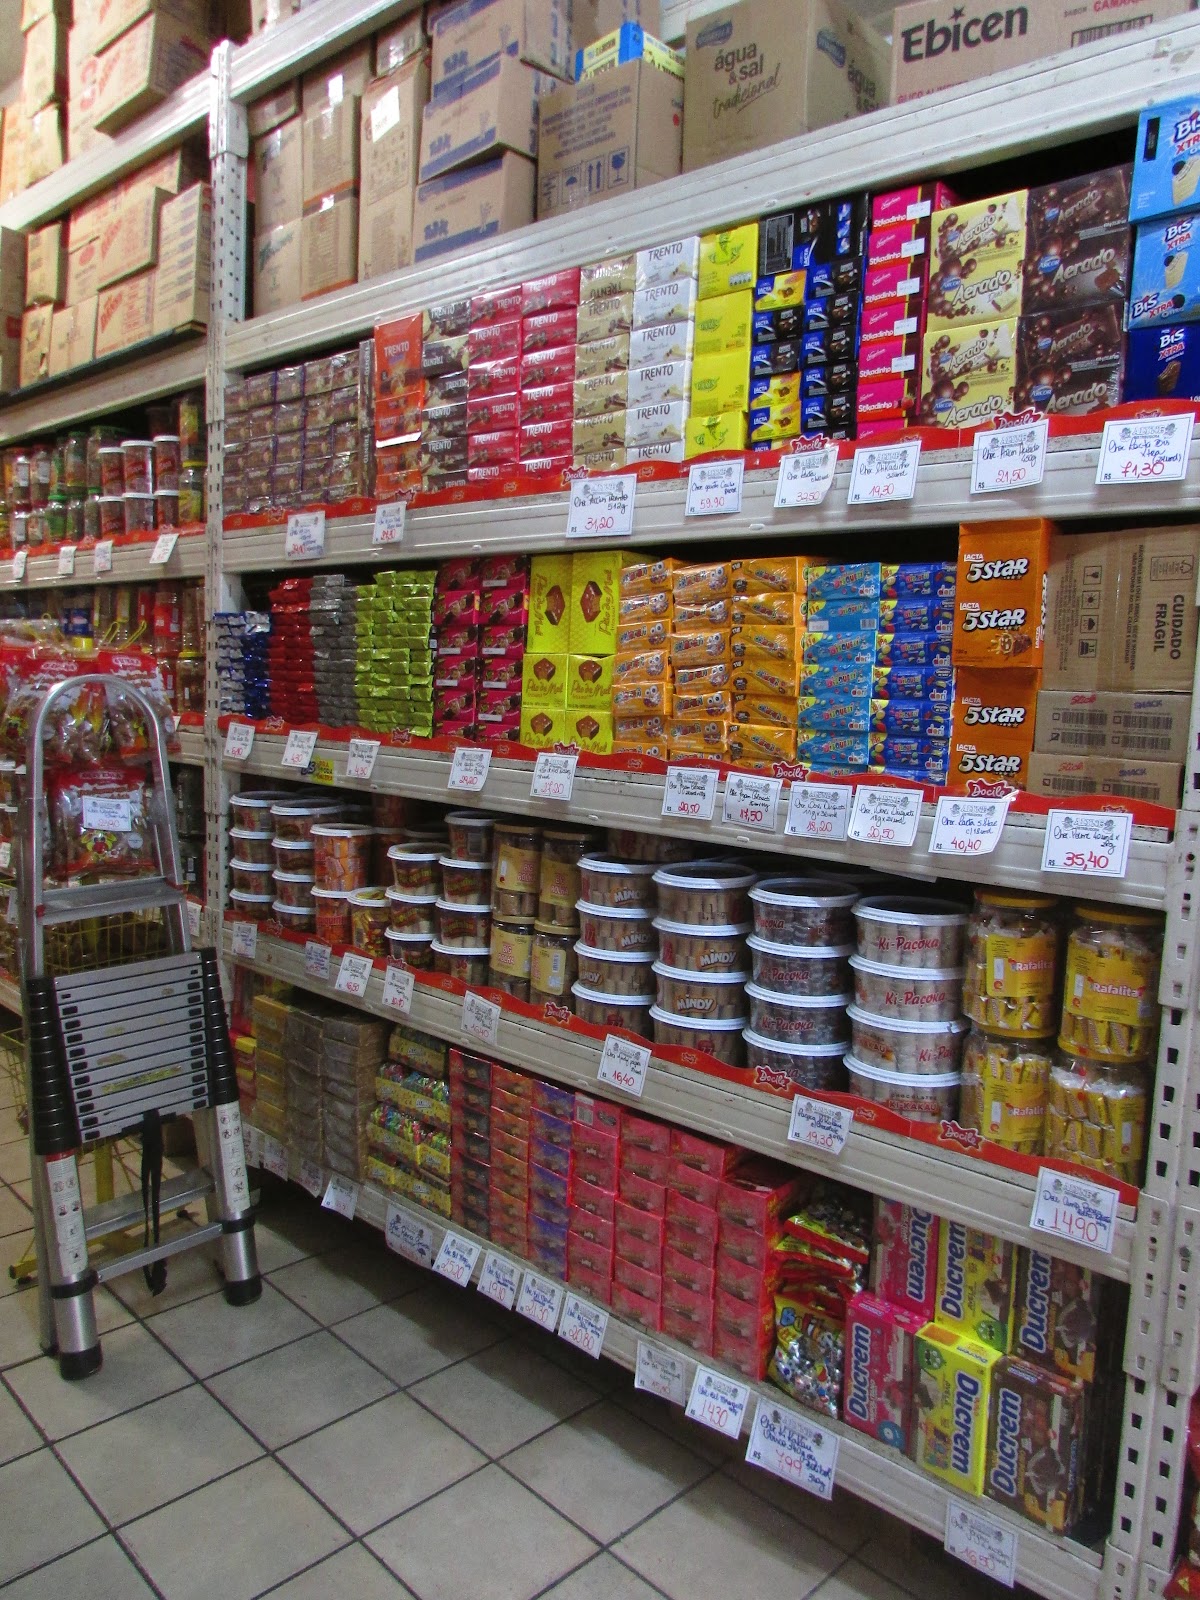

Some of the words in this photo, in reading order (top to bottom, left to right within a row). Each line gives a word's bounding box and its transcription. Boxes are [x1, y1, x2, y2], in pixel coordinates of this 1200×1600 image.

[901, 5, 1028, 63] Ebicen
[714, 42, 758, 73] água
[713, 62, 782, 119] tradicional
[1057, 189, 1099, 223] Aerado
[873, 213, 907, 227] Stikadinho
[956, 214, 998, 249] Aerado
[1167, 232, 1192, 252] XTRA
[648, 242, 683, 262] TRENTO
[869, 252, 901, 266] Stikadinho
[1052, 248, 1116, 285] Aerado
[529, 276, 557, 293] TRENTO
[644, 283, 679, 302] TRENTO
[953, 270, 1011, 306] Aerado
[497, 295, 520, 309] TRENTO
[865, 289, 897, 304] Stikadinho
[431, 305, 455, 319] TRENTO
[588, 298, 620, 317] TRENTO
[1149, 299, 1175, 319] XTRA
[528, 313, 558, 328] TRENTO
[475, 326, 500, 341] TRENTO
[642, 324, 676, 344] TRENTO
[862, 328, 894, 342] Stikadinho
[1050, 321, 1093, 353] Aerado
[384, 341, 409, 357] TRENTO
[950, 336, 988, 370] Aerado
[1158, 342, 1186, 360] XTRA
[423, 355, 444, 368] TRENTO
[528, 350, 556, 366] TRENTO
[493, 366, 516, 380] TRENTO
[639, 364, 674, 382] TRENTO
[859, 364, 892, 378] Stikadinho
[584, 375, 616, 392] TRENTO
[527, 387, 554, 402] TRENTO
[1046, 381, 1107, 413] Aerado
[428, 407, 450, 419] TRENTO
[491, 402, 515, 415] TRENTO
[636, 403, 671, 420] TRENTO
[858, 400, 893, 414] Stikadinho
[944, 395, 1003, 428] Aerado
[1000, 413, 1034, 428] Docile
[474, 432, 499, 444] TRENTO
[525, 423, 553, 437] TRENTO
[428, 441, 452, 452] TRENTO
[637, 443, 671, 459] TRENTO
[795, 437, 822, 453] Docile
[525, 458, 551, 473] TRENTO
[583, 450, 615, 466] TRENTO
[474, 466, 499, 479] TRENTO
[995, 467, 1026, 485] 21,50
[869, 483, 895, 498] 19,30
[585, 516, 614, 533] 31,20
[964, 553, 984, 562] LACTA
[858, 585, 875, 596] dori
[937, 584, 955, 598] dori
[960, 602, 980, 610] LACTA
[935, 621, 953, 633] dori
[1153, 603, 1170, 653] FRÁGIL
[1169, 594, 1185, 661] CUIDADO
[854, 653, 871, 664] dori
[932, 654, 950, 667] dori
[850, 687, 867, 698] dori
[929, 689, 947, 702] dori
[961, 696, 981, 704] LACTA
[847, 720, 864, 730] dori
[926, 724, 944, 737] dori
[956, 744, 976, 752] LACTA
[925, 758, 943, 771] dori
[777, 767, 804, 779] Docile
[972, 783, 1005, 797] Docile
[678, 801, 700, 814] 20,50
[867, 825, 894, 842] 20,50
[950, 837, 982, 853] 40,40
[1063, 850, 1109, 871] 35,40
[877, 937, 941, 951] Ki-Paçoka
[700, 949, 736, 966] MINDY
[1091, 981, 1140, 997] Rafalita
[676, 994, 712, 1012] MINDY
[885, 991, 946, 1006] Ki-Paçoka
[762, 1016, 814, 1033] Ki-Paçoka
[612, 1070, 635, 1087] 16,40
[759, 1069, 787, 1087] Docile
[889, 1100, 936, 1112] KI-KAKAU
[945, 1124, 978, 1145] Docile
[1051, 1207, 1098, 1242] 14.90
[941, 1220, 967, 1319] Ducrem
[1020, 1250, 1050, 1351] Ducrem
[849, 1324, 871, 1421] Ducrem
[951, 1372, 981, 1475] Ducrem
[991, 1389, 1021, 1496] Ducrem
